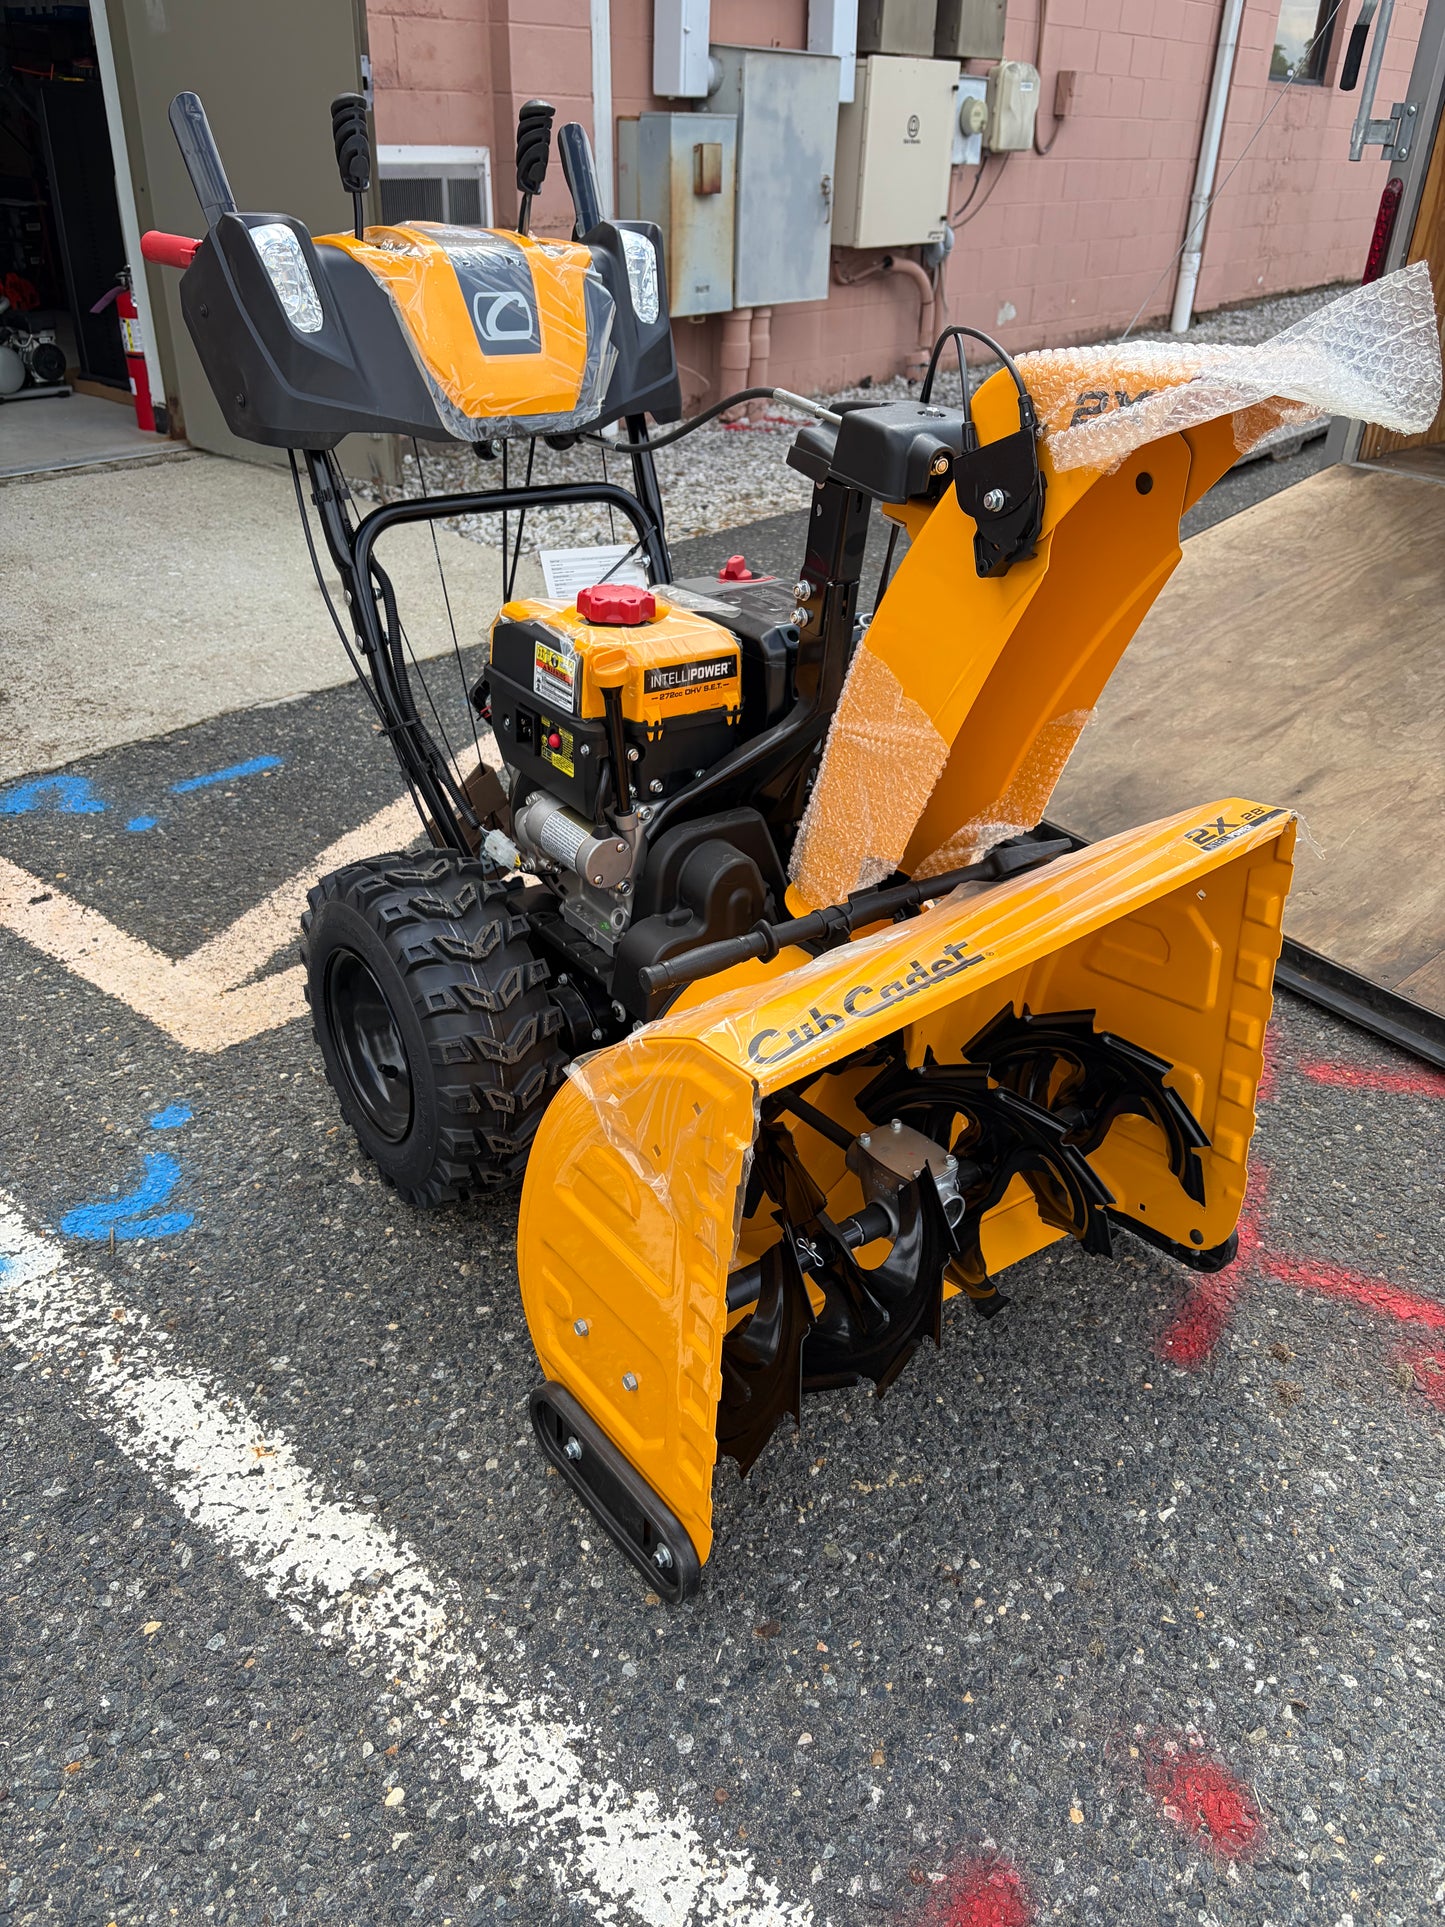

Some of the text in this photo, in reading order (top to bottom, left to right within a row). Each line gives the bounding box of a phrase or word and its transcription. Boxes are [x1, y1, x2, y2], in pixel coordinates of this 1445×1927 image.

[650, 662, 731, 688] INTELLIPOWER
[660, 691, 683, 700] 272cc
[685, 687, 702, 696] OHV
[1184, 816, 1240, 845] 2X
[747, 941, 986, 1065] Cub Cadet
